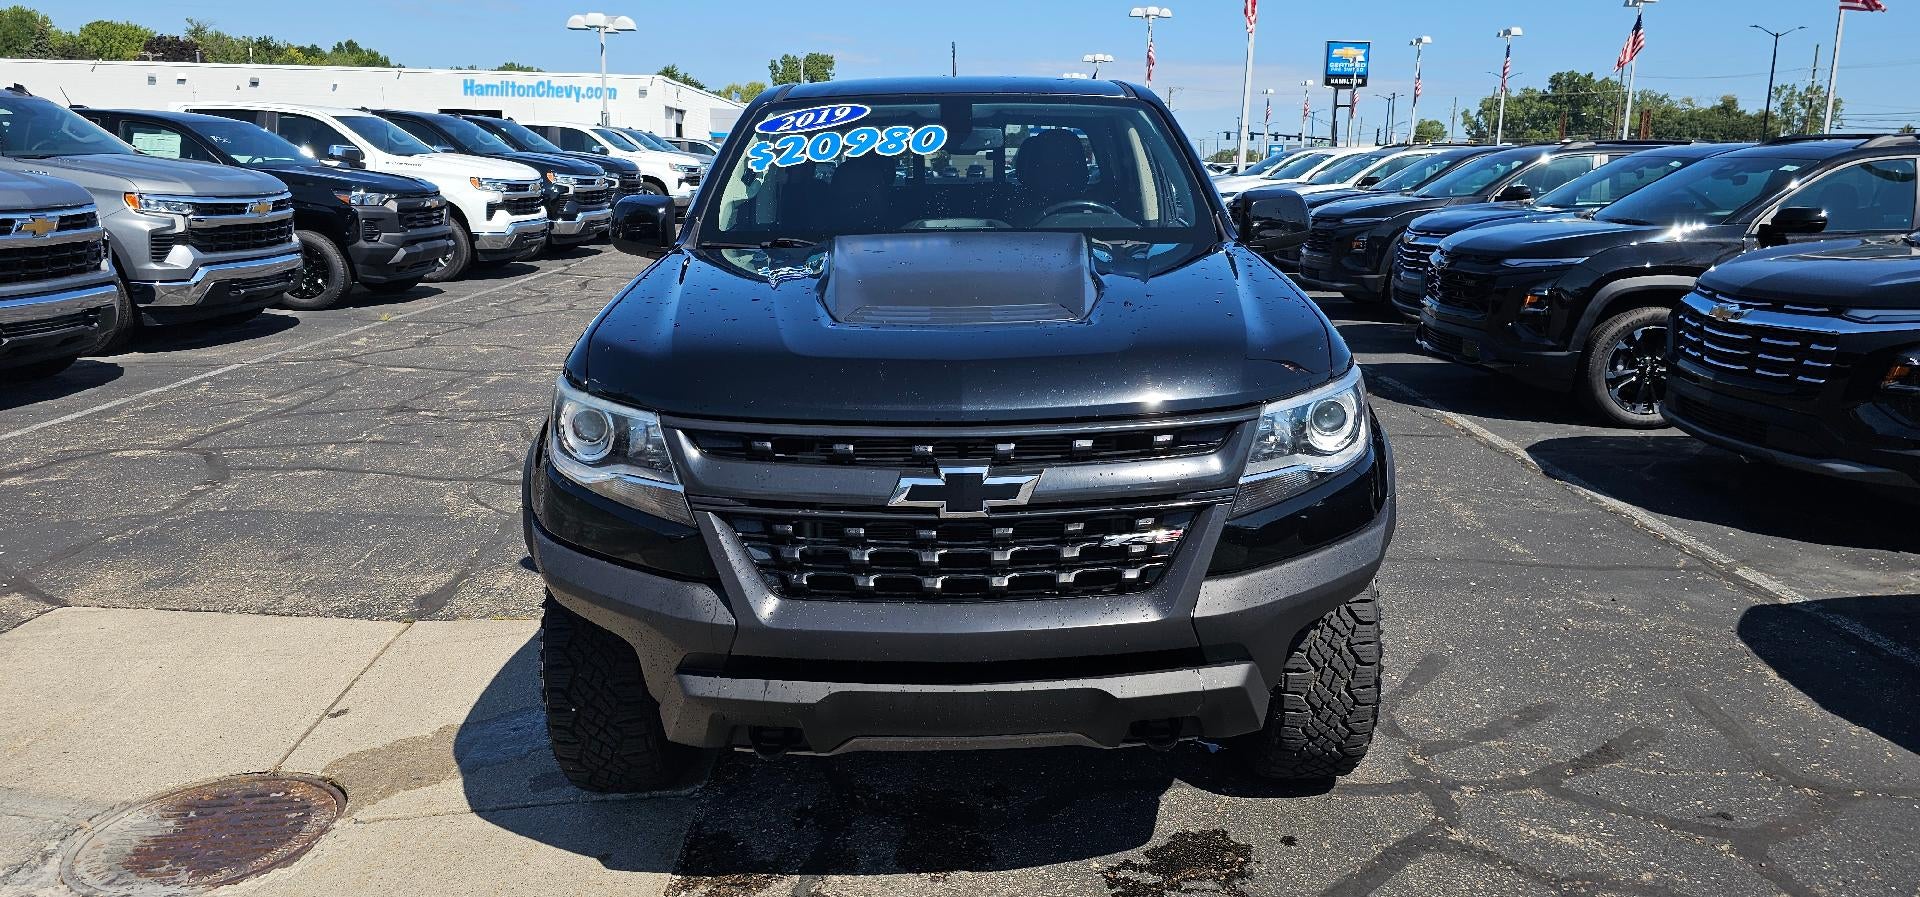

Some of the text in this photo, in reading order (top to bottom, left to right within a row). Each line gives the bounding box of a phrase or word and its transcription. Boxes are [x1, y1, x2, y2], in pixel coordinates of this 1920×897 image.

[462, 78, 618, 102] HamiltonChevy.com
[776, 106, 851, 132] 2019
[747, 124, 948, 173] $20980
